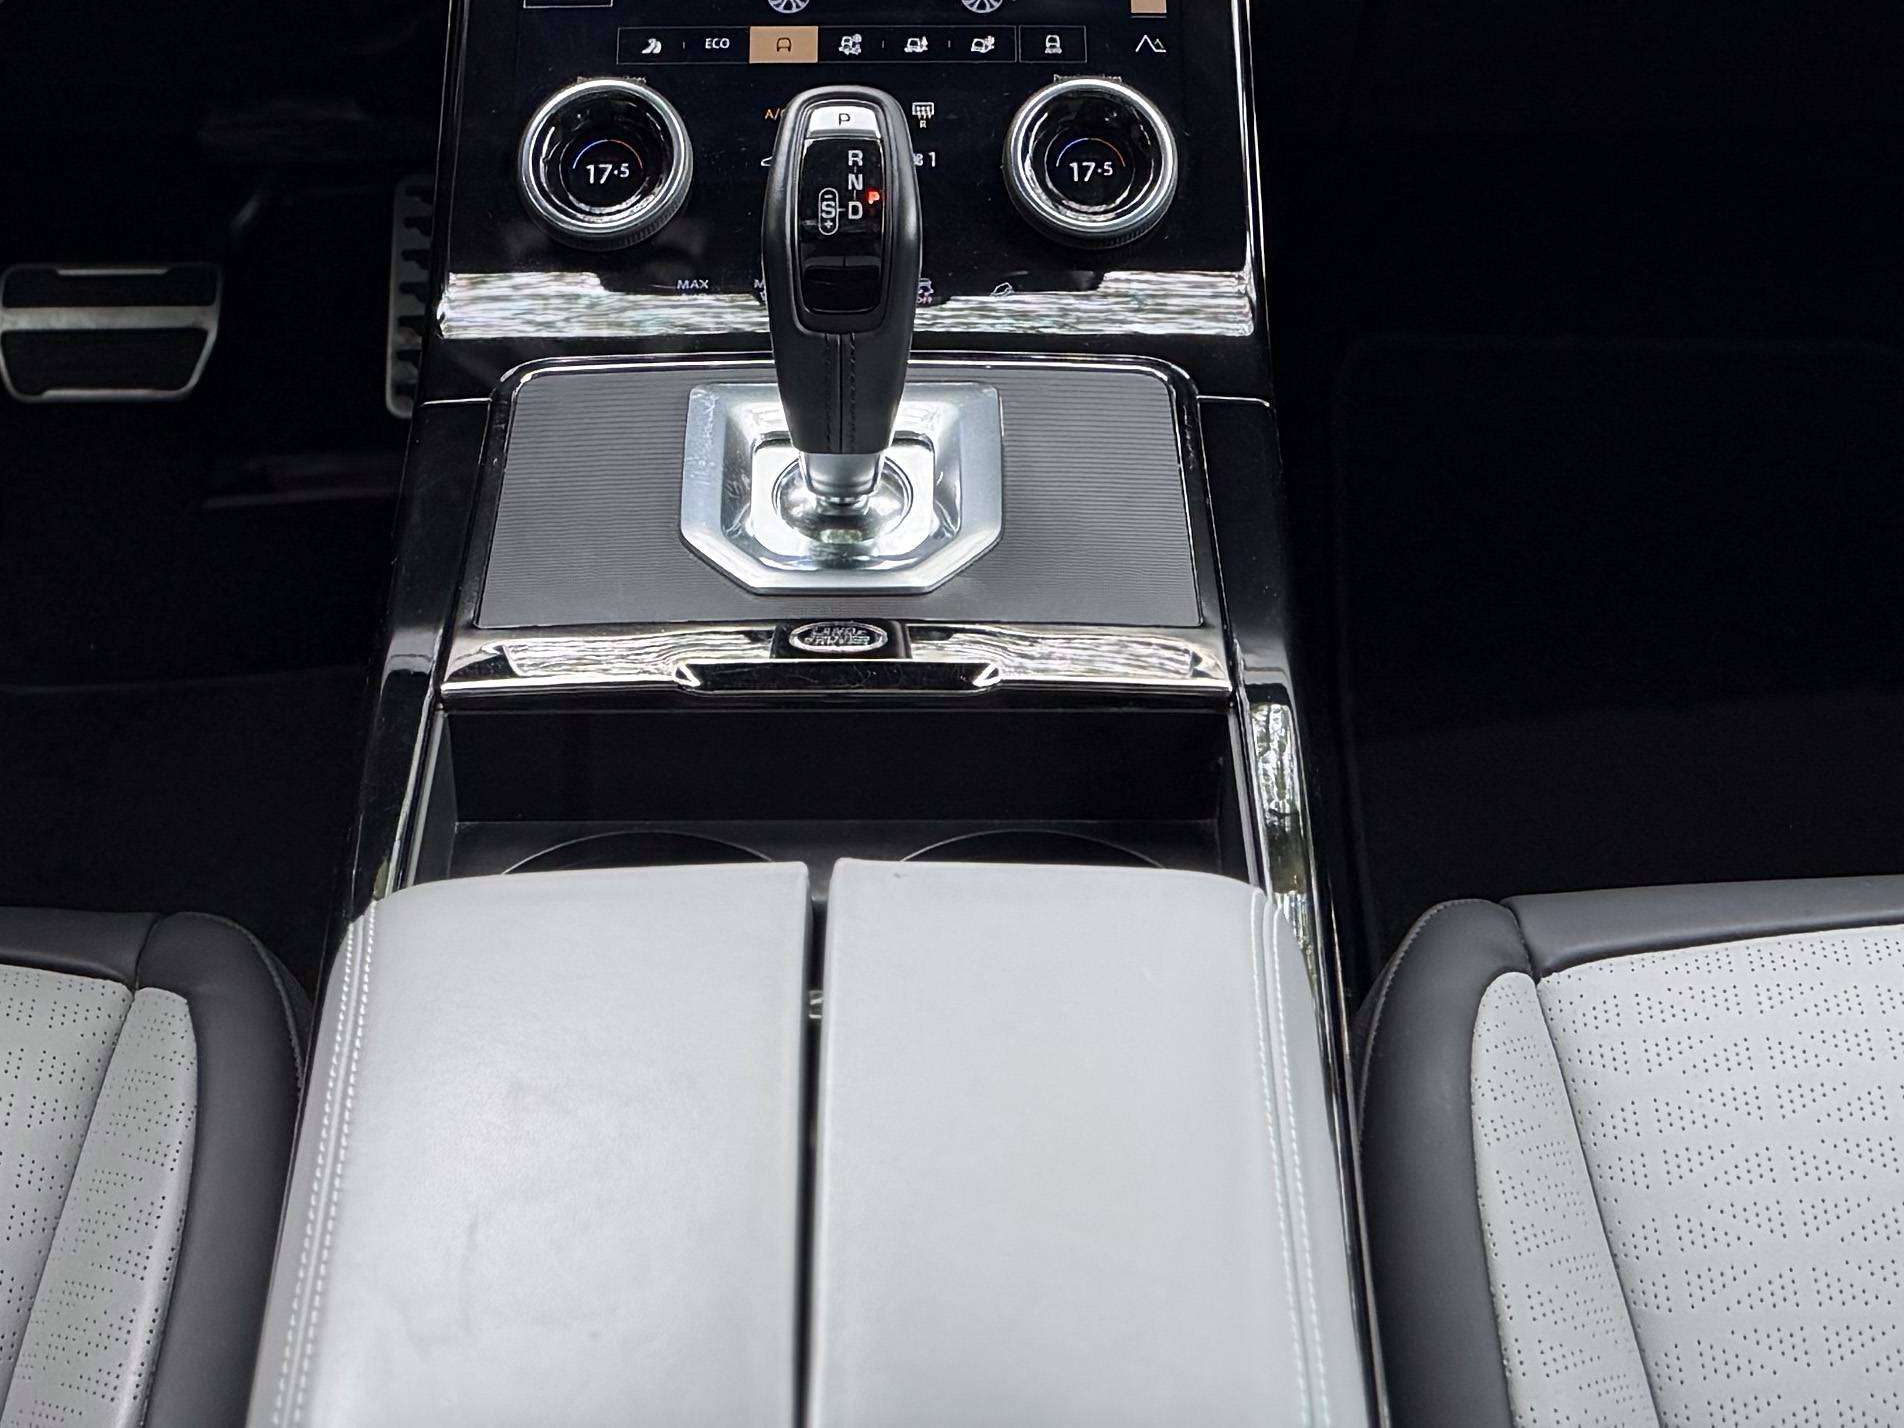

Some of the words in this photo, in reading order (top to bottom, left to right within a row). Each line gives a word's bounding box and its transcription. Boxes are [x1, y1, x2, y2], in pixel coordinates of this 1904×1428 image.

[705, 38, 730, 49] ECO
[838, 113, 851, 126] P
[848, 150, 863, 166] R
[928, 151, 936, 167] 1
[848, 174, 863, 191] N
[868, 191, 880, 204] P
[821, 201, 836, 219] S
[848, 201, 863, 219] D
[677, 279, 709, 290] MAX
